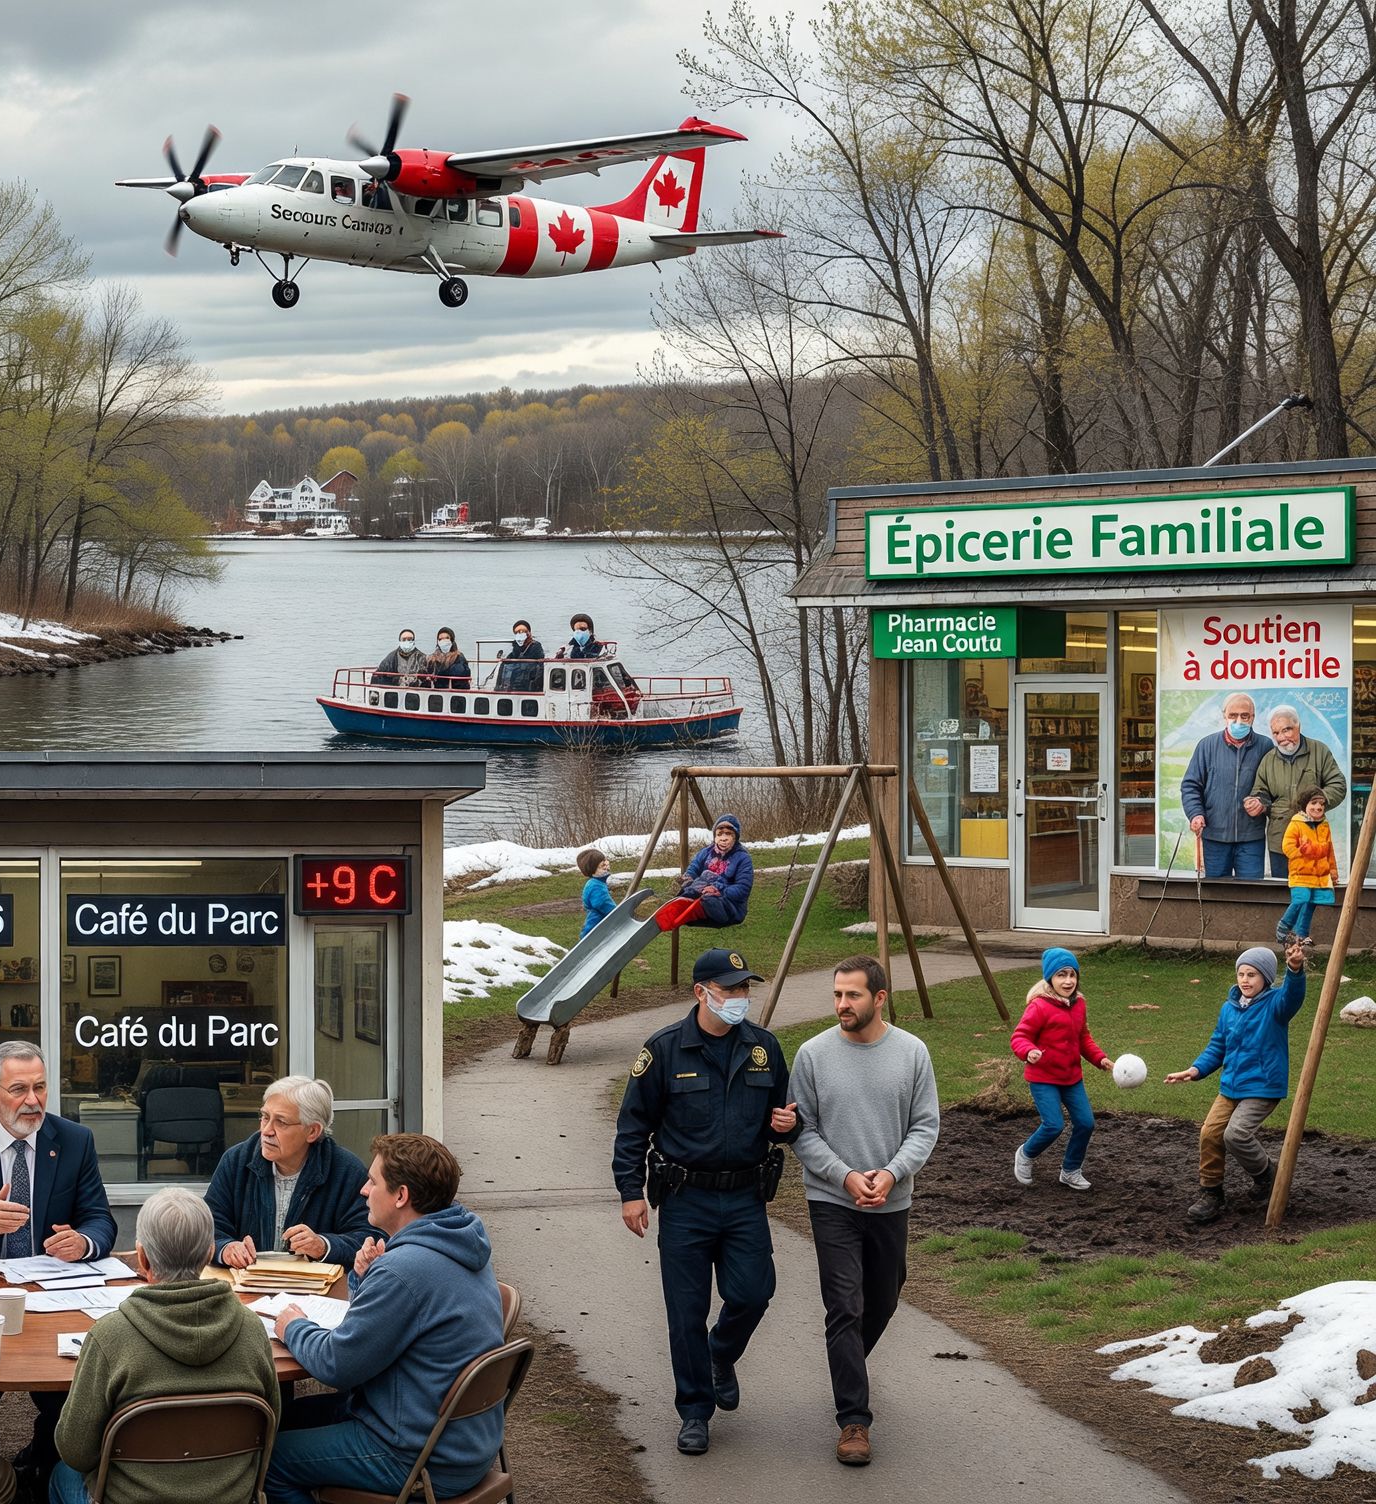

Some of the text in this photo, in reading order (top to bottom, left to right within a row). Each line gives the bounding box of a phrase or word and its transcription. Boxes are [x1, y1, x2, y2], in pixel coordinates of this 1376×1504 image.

[887, 503, 1324, 573] Épicerie Familiale
[888, 611, 996, 633] Pharmacie
[1203, 614, 1321, 646] Soutien
[891, 635, 937, 654] Jean
[1183, 649, 1341, 681] à domicile
[306, 864, 397, 905] +9 C
[75, 903, 279, 935] Café du Parc
[75, 1015, 279, 1047] Café du Parc
